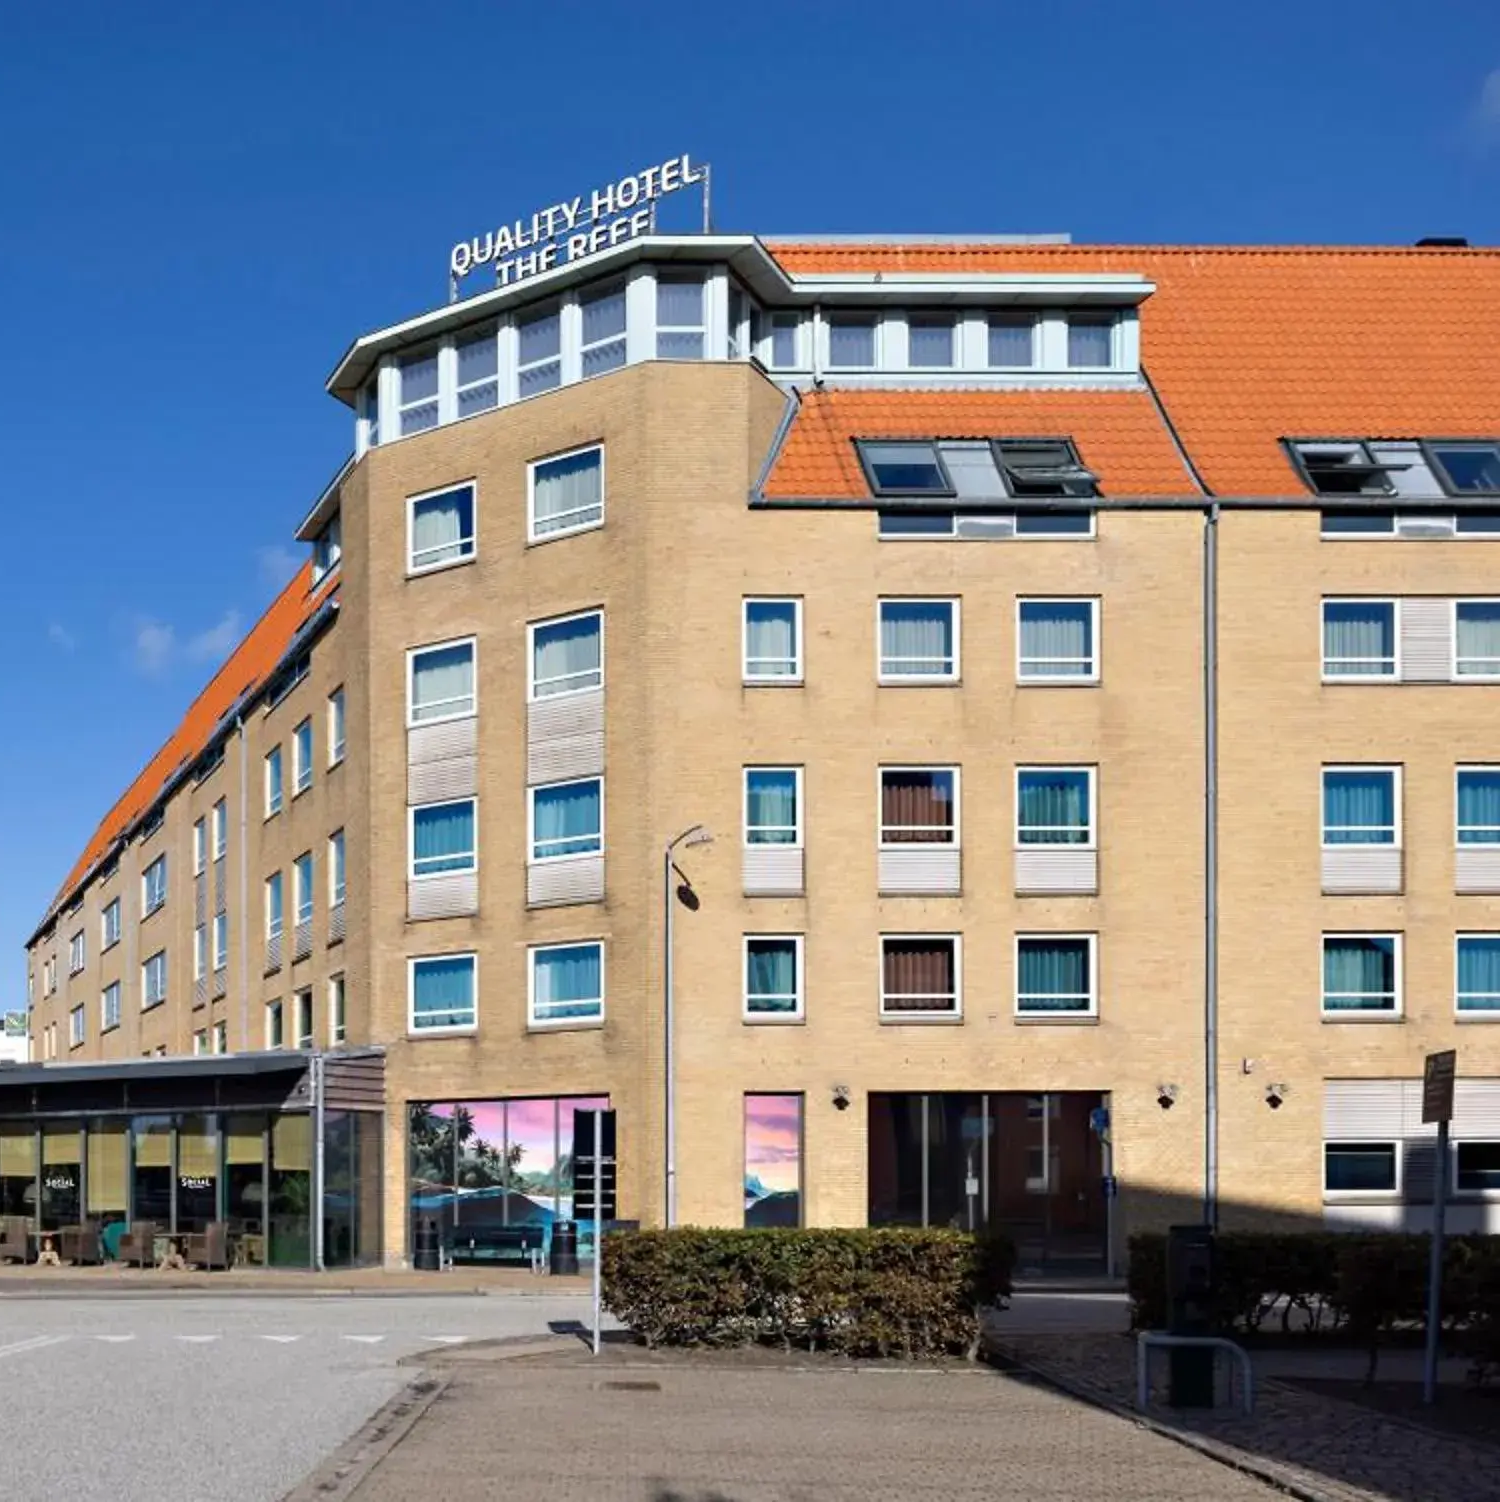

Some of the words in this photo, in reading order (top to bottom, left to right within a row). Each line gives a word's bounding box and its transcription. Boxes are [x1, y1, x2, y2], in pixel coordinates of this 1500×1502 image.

[451, 196, 582, 276] QUALITY
[591, 153, 701, 219] HOTEL
[496, 242, 557, 285] THE
[567, 208, 650, 261] REEF
